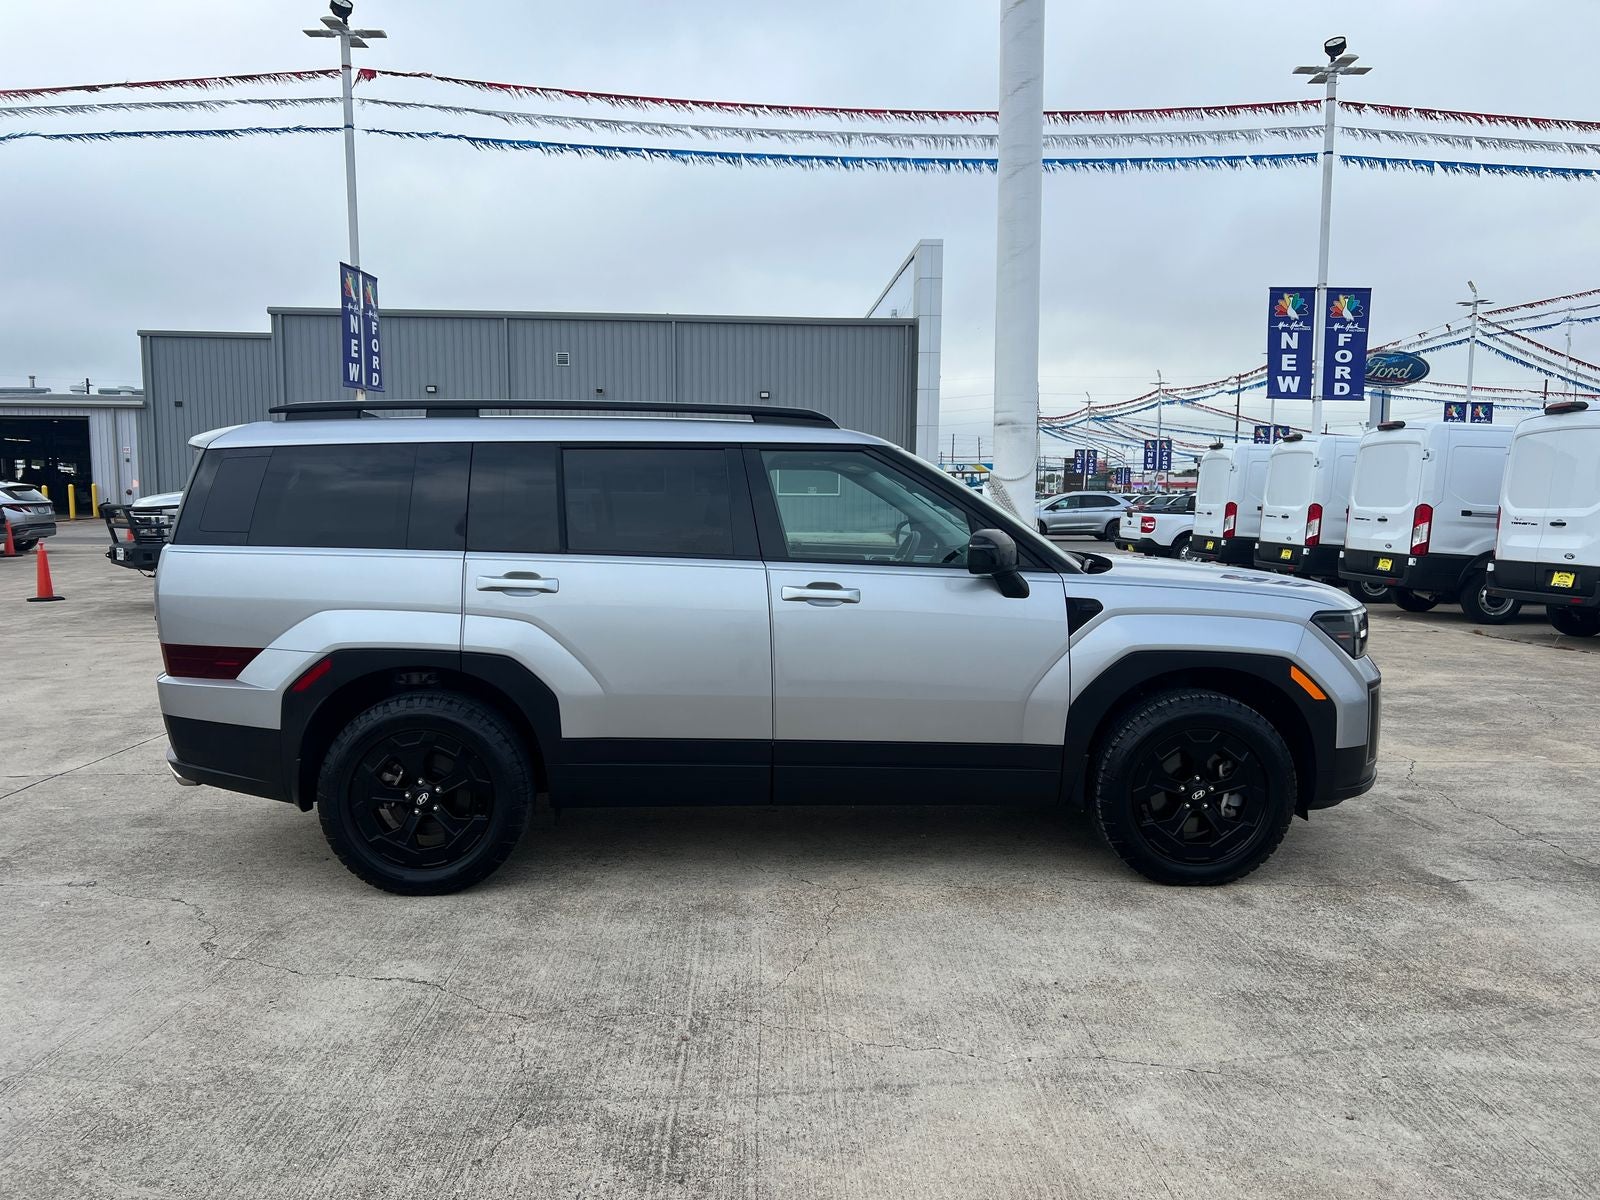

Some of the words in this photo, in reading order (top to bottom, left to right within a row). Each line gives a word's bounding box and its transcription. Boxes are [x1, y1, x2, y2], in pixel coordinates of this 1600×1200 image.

[349, 315, 359, 382] NEW
[371, 322, 379, 386] FORD
[1277, 332, 1300, 393] NEW
[1334, 333, 1353, 396] FORD
[1365, 356, 1414, 379] Ford
[1146, 452, 1154, 469] NEW
